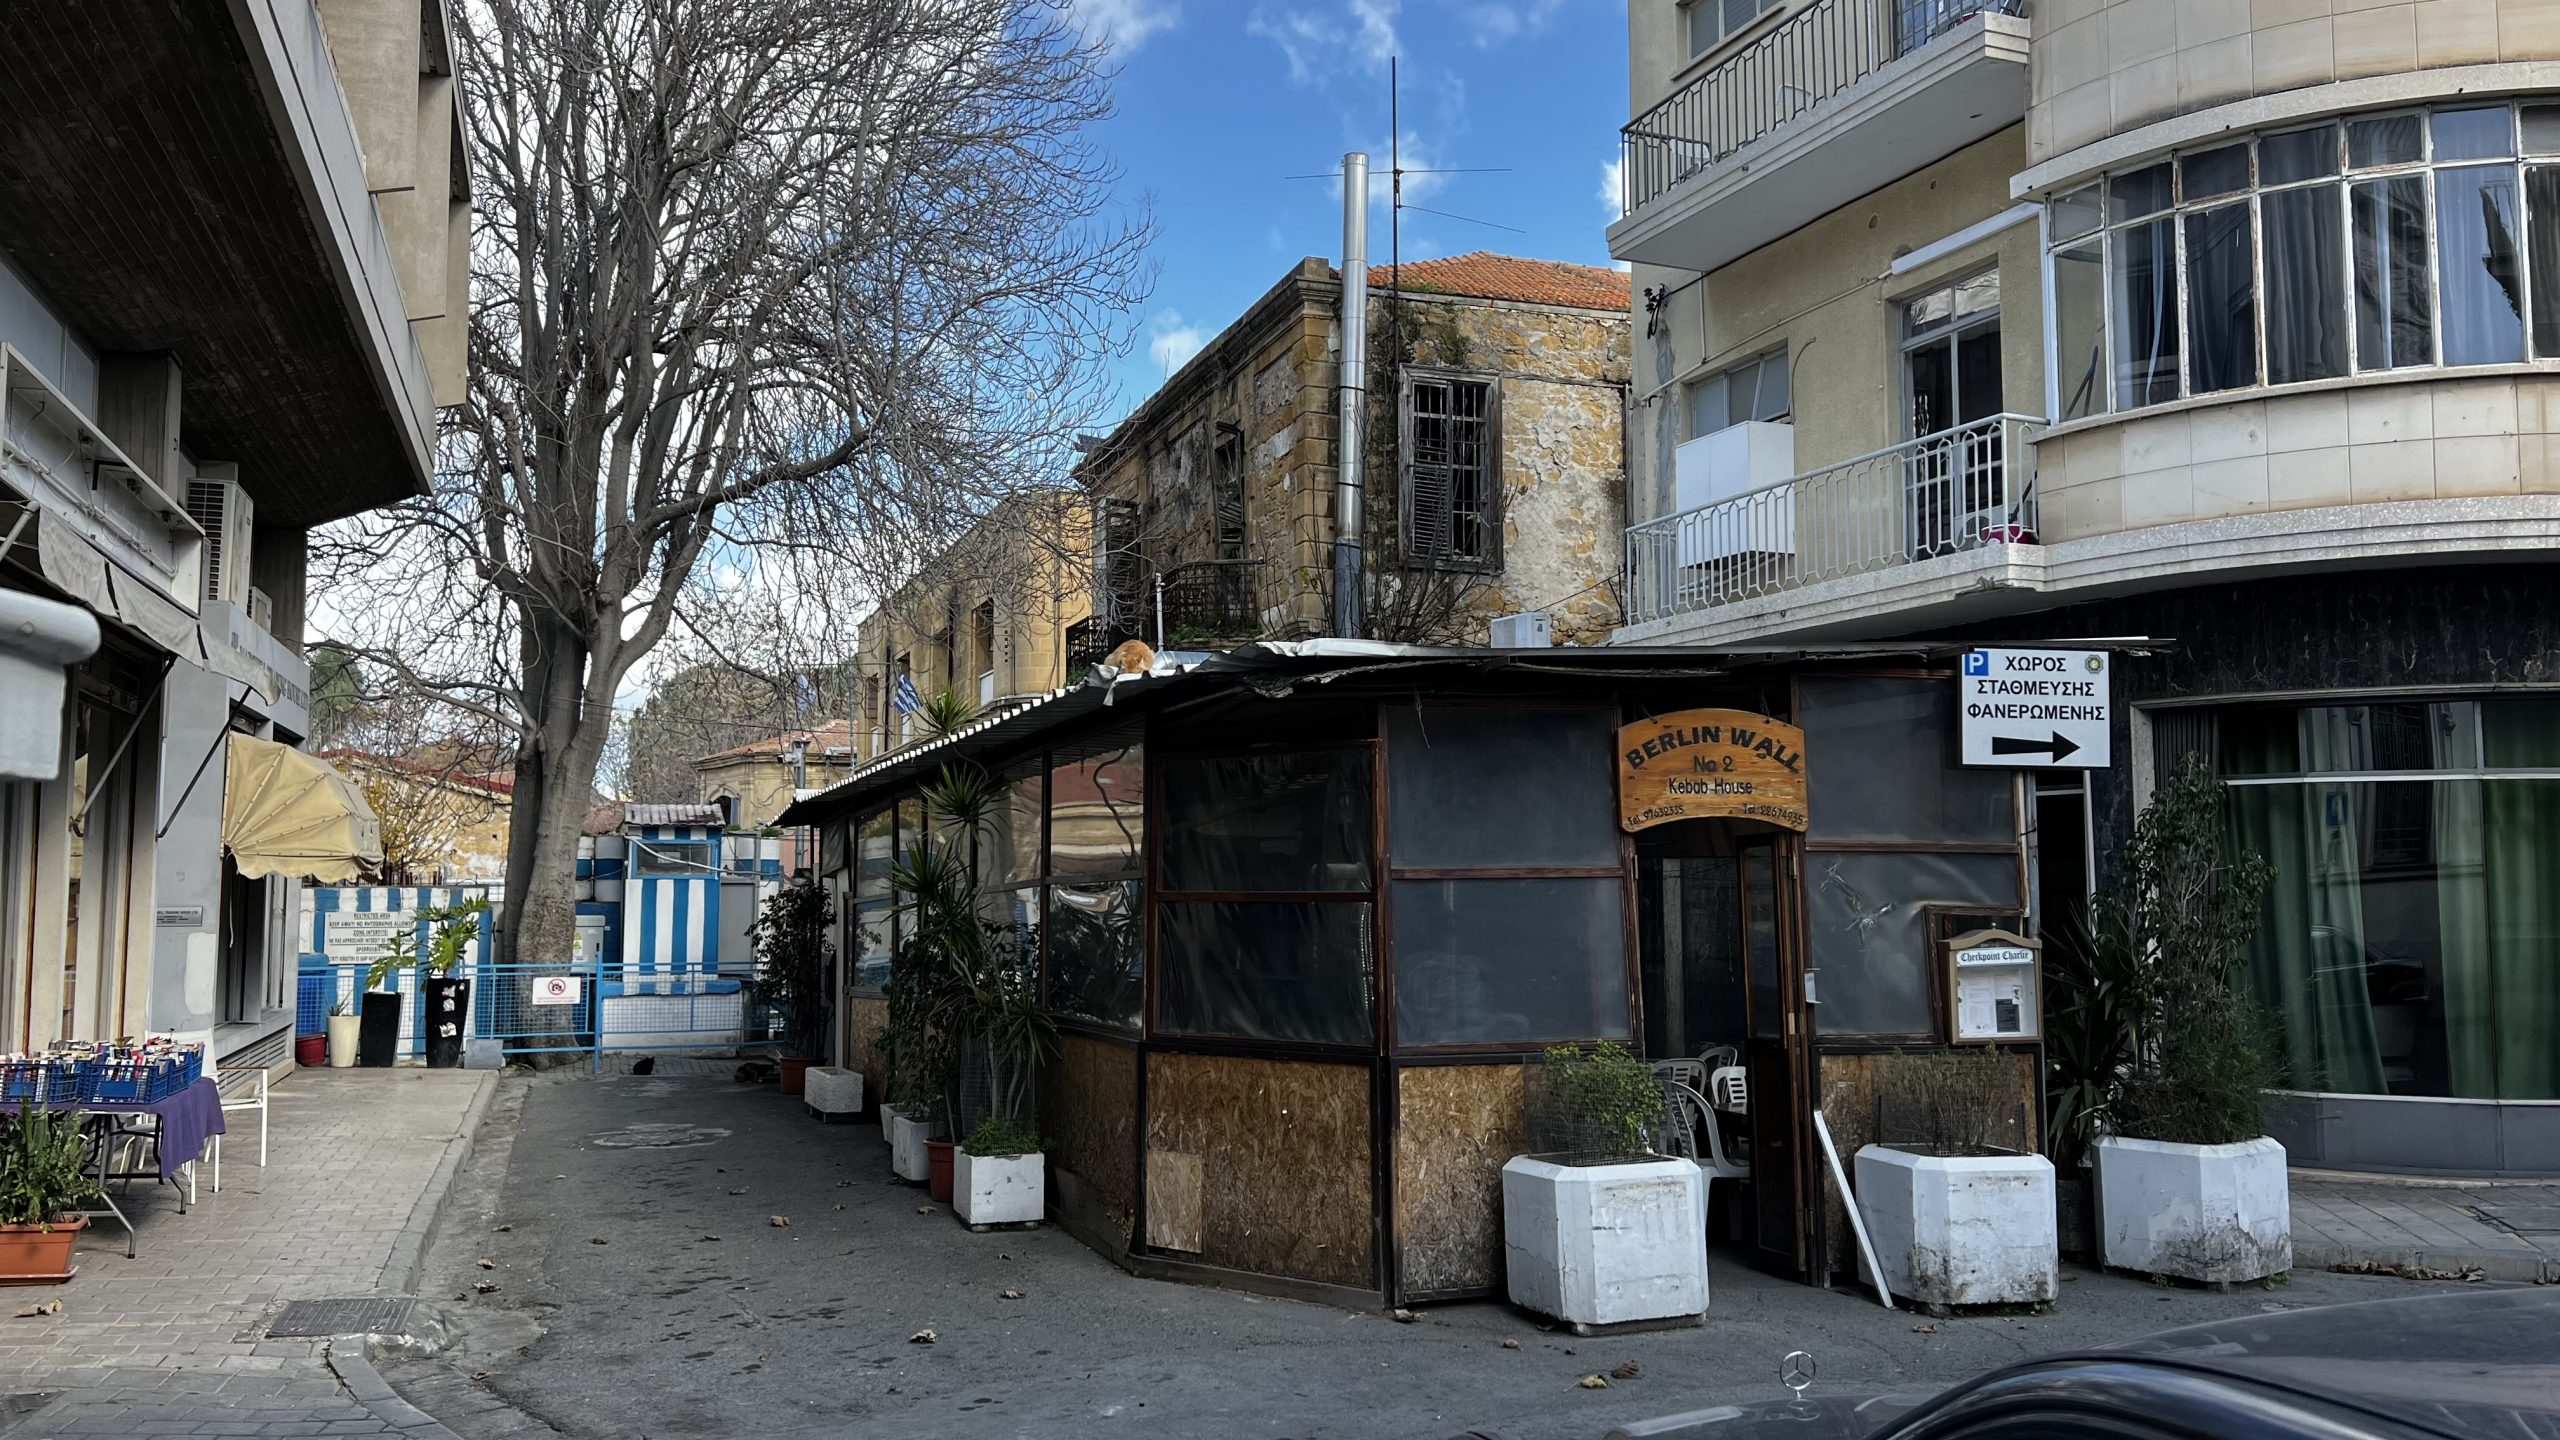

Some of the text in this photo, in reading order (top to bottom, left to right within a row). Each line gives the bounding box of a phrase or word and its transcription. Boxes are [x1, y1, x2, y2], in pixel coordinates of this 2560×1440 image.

[2005, 656, 2067, 672] ΧΩΡΟΣ
[1977, 680, 2095, 696] ΣΤΑΘΜΕΥΣΗΣ
[1967, 703, 2105, 720] ΦΑΝΕΡΩΜΕΝΗΣ
[1625, 726, 1801, 774] BERLIN WALL
[1722, 755, 1735, 773] 2
[1669, 777, 1754, 794] Kebab House
[1960, 950, 2029, 963] Checkpoint Charlie
